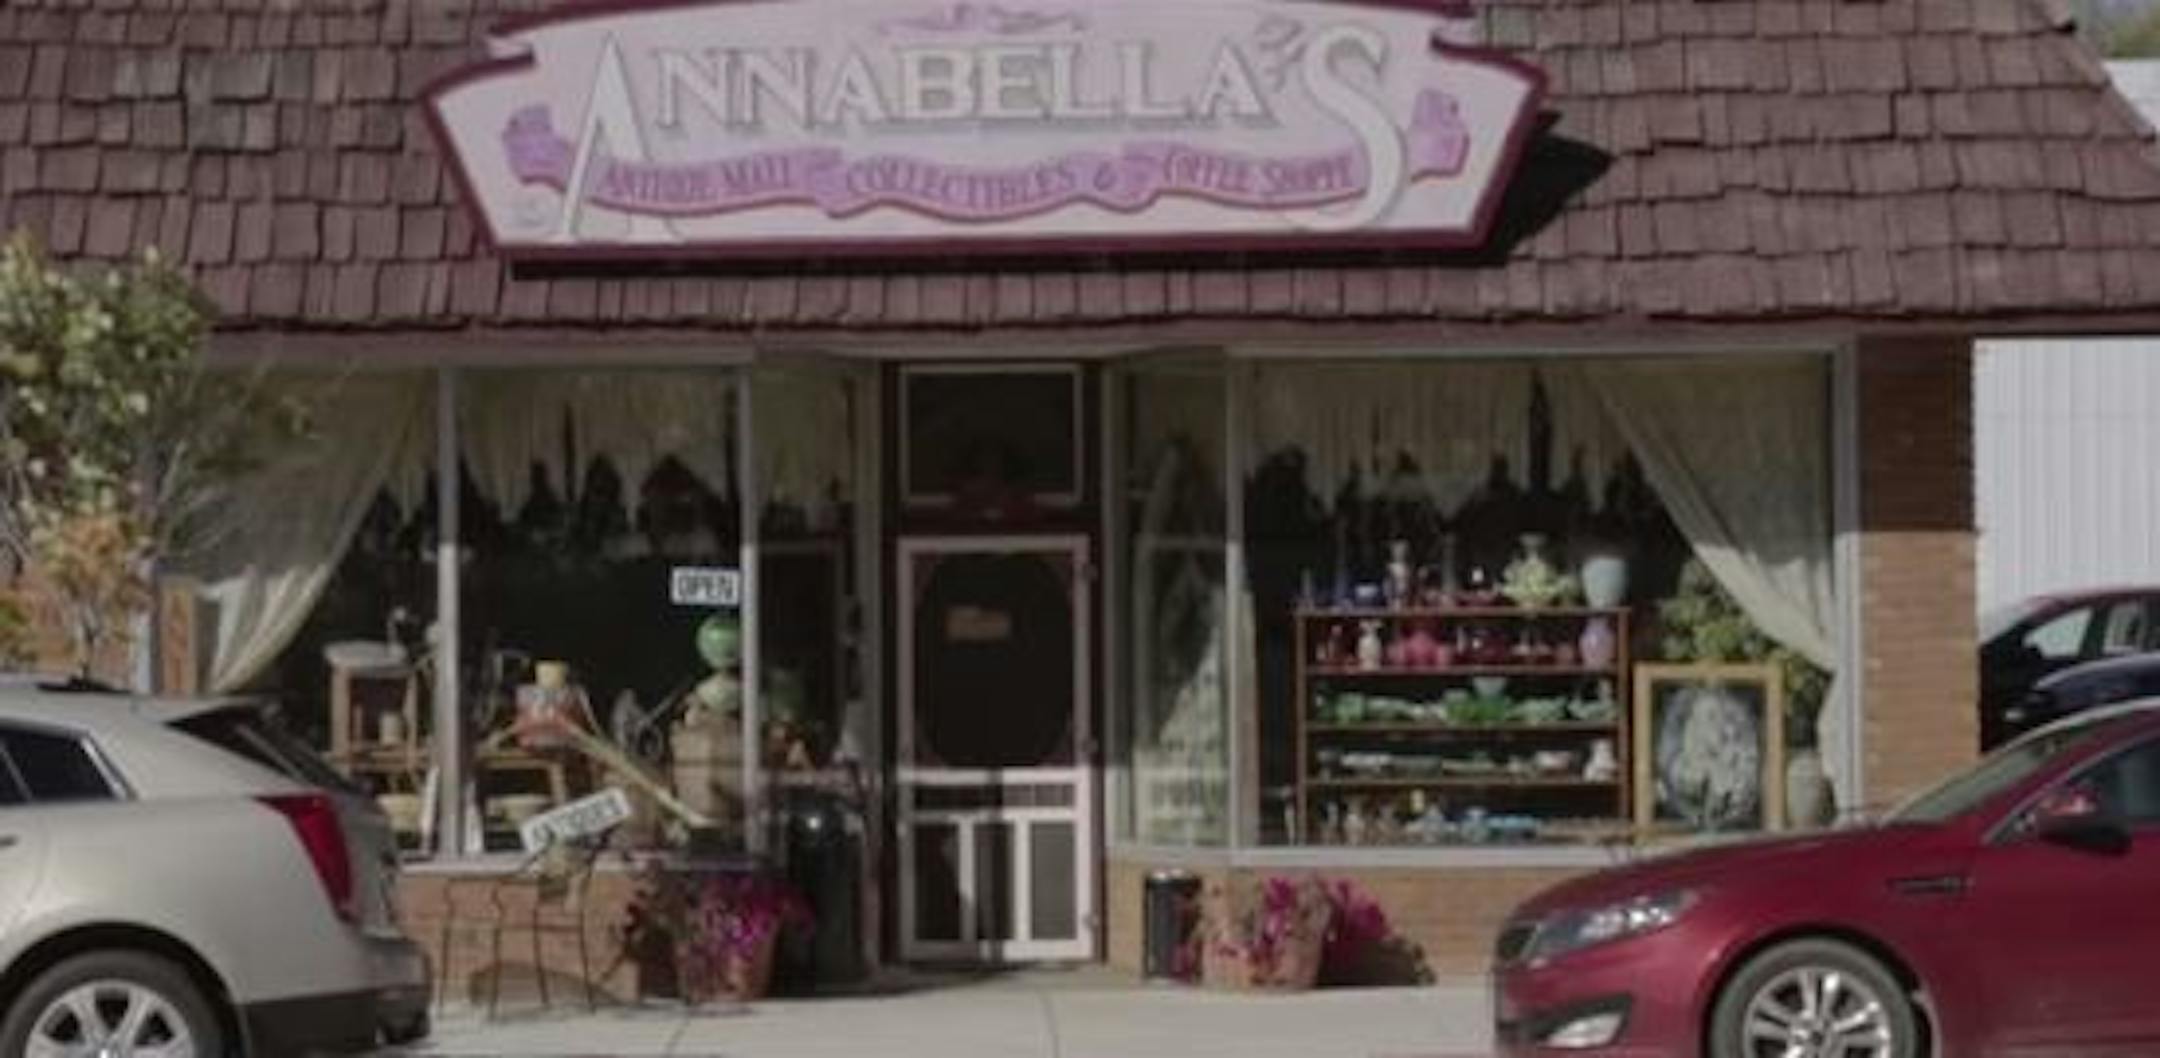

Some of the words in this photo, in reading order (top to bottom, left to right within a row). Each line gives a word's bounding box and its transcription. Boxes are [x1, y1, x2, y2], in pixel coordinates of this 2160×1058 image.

[553, 24, 1408, 242] ANNABELLA'S
[846, 155, 1075, 209] COLLECTIBLES
[1163, 150, 1252, 193] COFFEE
[678, 574, 735, 601] OPEN
